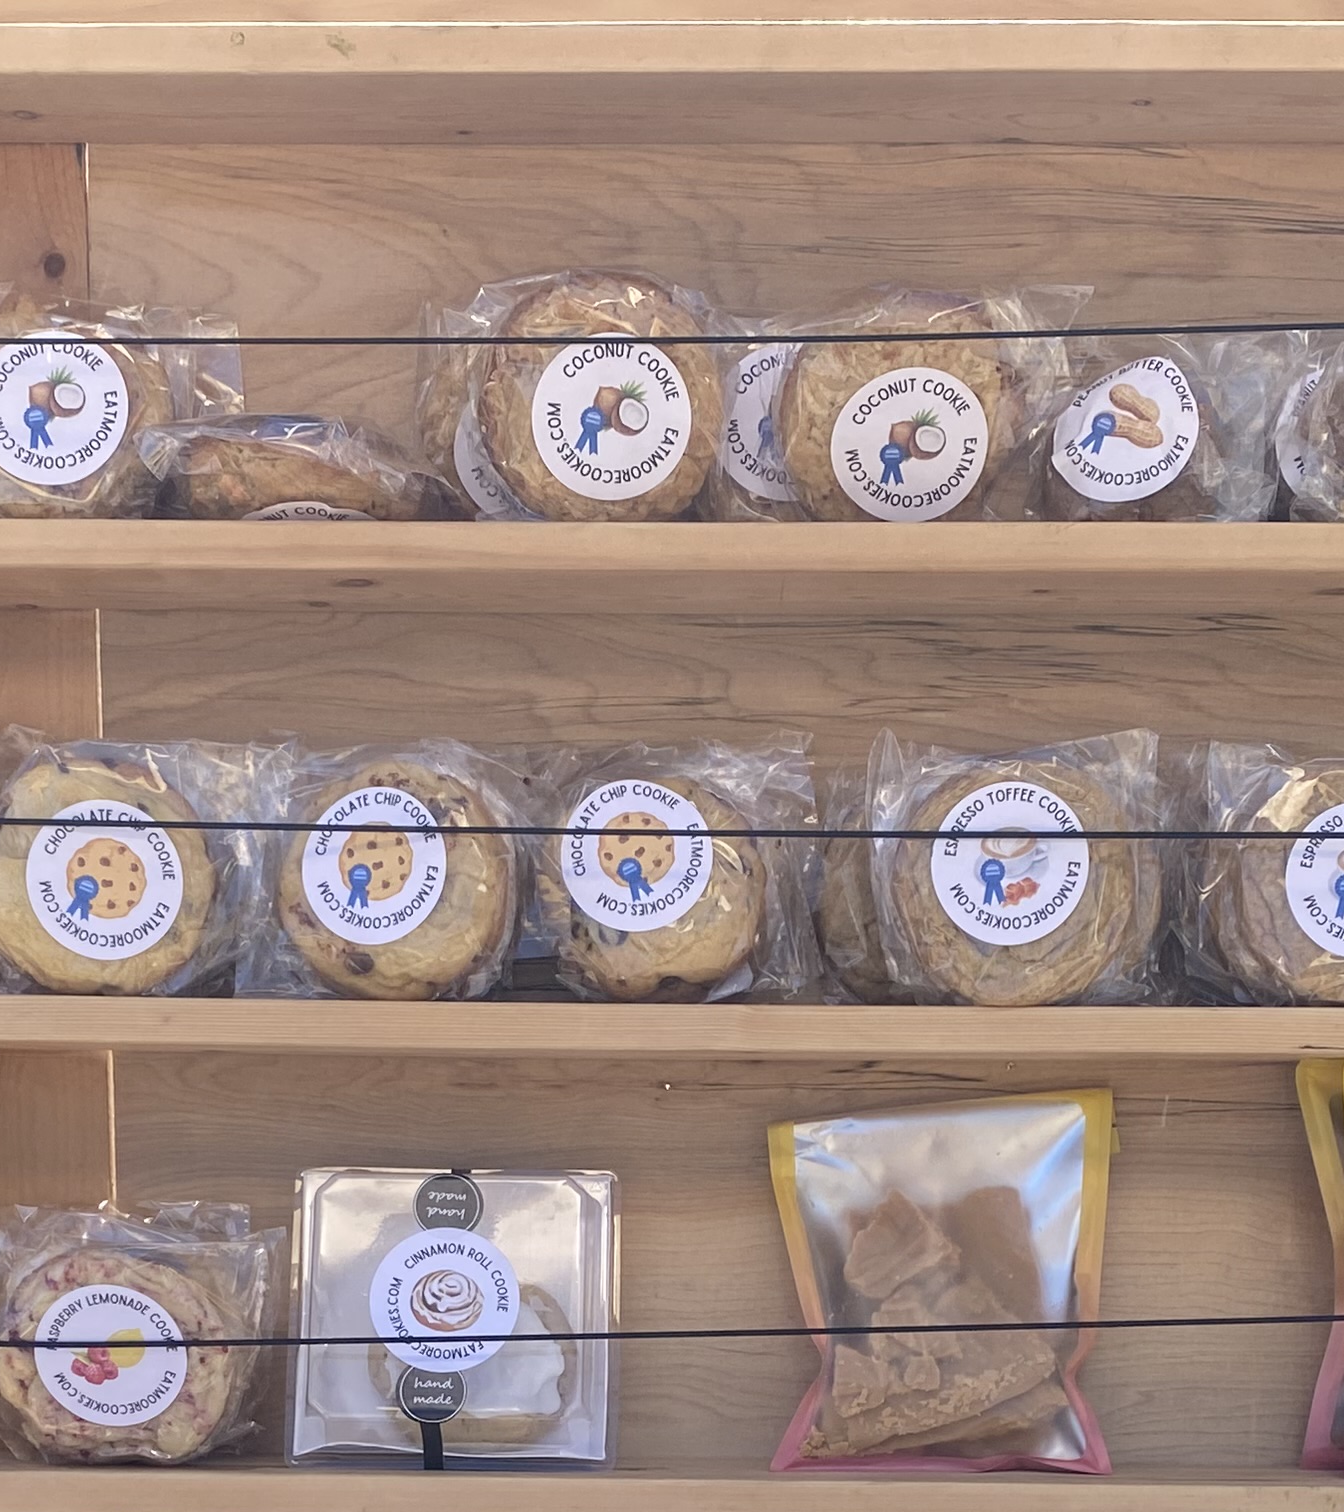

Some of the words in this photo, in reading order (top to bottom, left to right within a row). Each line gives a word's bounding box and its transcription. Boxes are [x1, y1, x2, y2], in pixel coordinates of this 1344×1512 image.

[51, 343, 104, 372] COOKIE
[563, 343, 635, 378] COCONUT
[638, 352, 679, 401] COOKIE
[852, 378, 916, 425] COCONUT
[923, 379, 970, 416] COOKIE
[1164, 367, 1193, 412] COOKIE
[547, 402, 679, 484] EATMOORECOOKIES.COM
[845, 437, 977, 508] EATMOORECOOKIES.COM
[600, 785, 627, 803] CHIP
[633, 784, 680, 810] COOKIE
[986, 787, 1036, 805] TOFFEE
[315, 794, 370, 855] CHOCOLATE
[374, 792, 401, 806] CHIP
[147, 832, 176, 880] COOKIE
[39, 880, 169, 947] EATMOORECOOKIES.COM
[317, 865, 438, 928] EATMOORECOOKIES.COM
[950, 860, 1080, 930] EATMOORECOOKIES.COM
[426, 1206, 465, 1219] hand
[427, 1190, 466, 1201] made
[404, 1242, 465, 1270] CINNAMON
[467, 1248, 493, 1271] ROLL
[491, 1269, 509, 1313] COOKIE
[86, 1293, 150, 1316] LEMONADE
[54, 1370, 176, 1415] EATMOORECOOKIES.COM
[413, 1376, 454, 1390] hand
[413, 1394, 453, 1405] made
